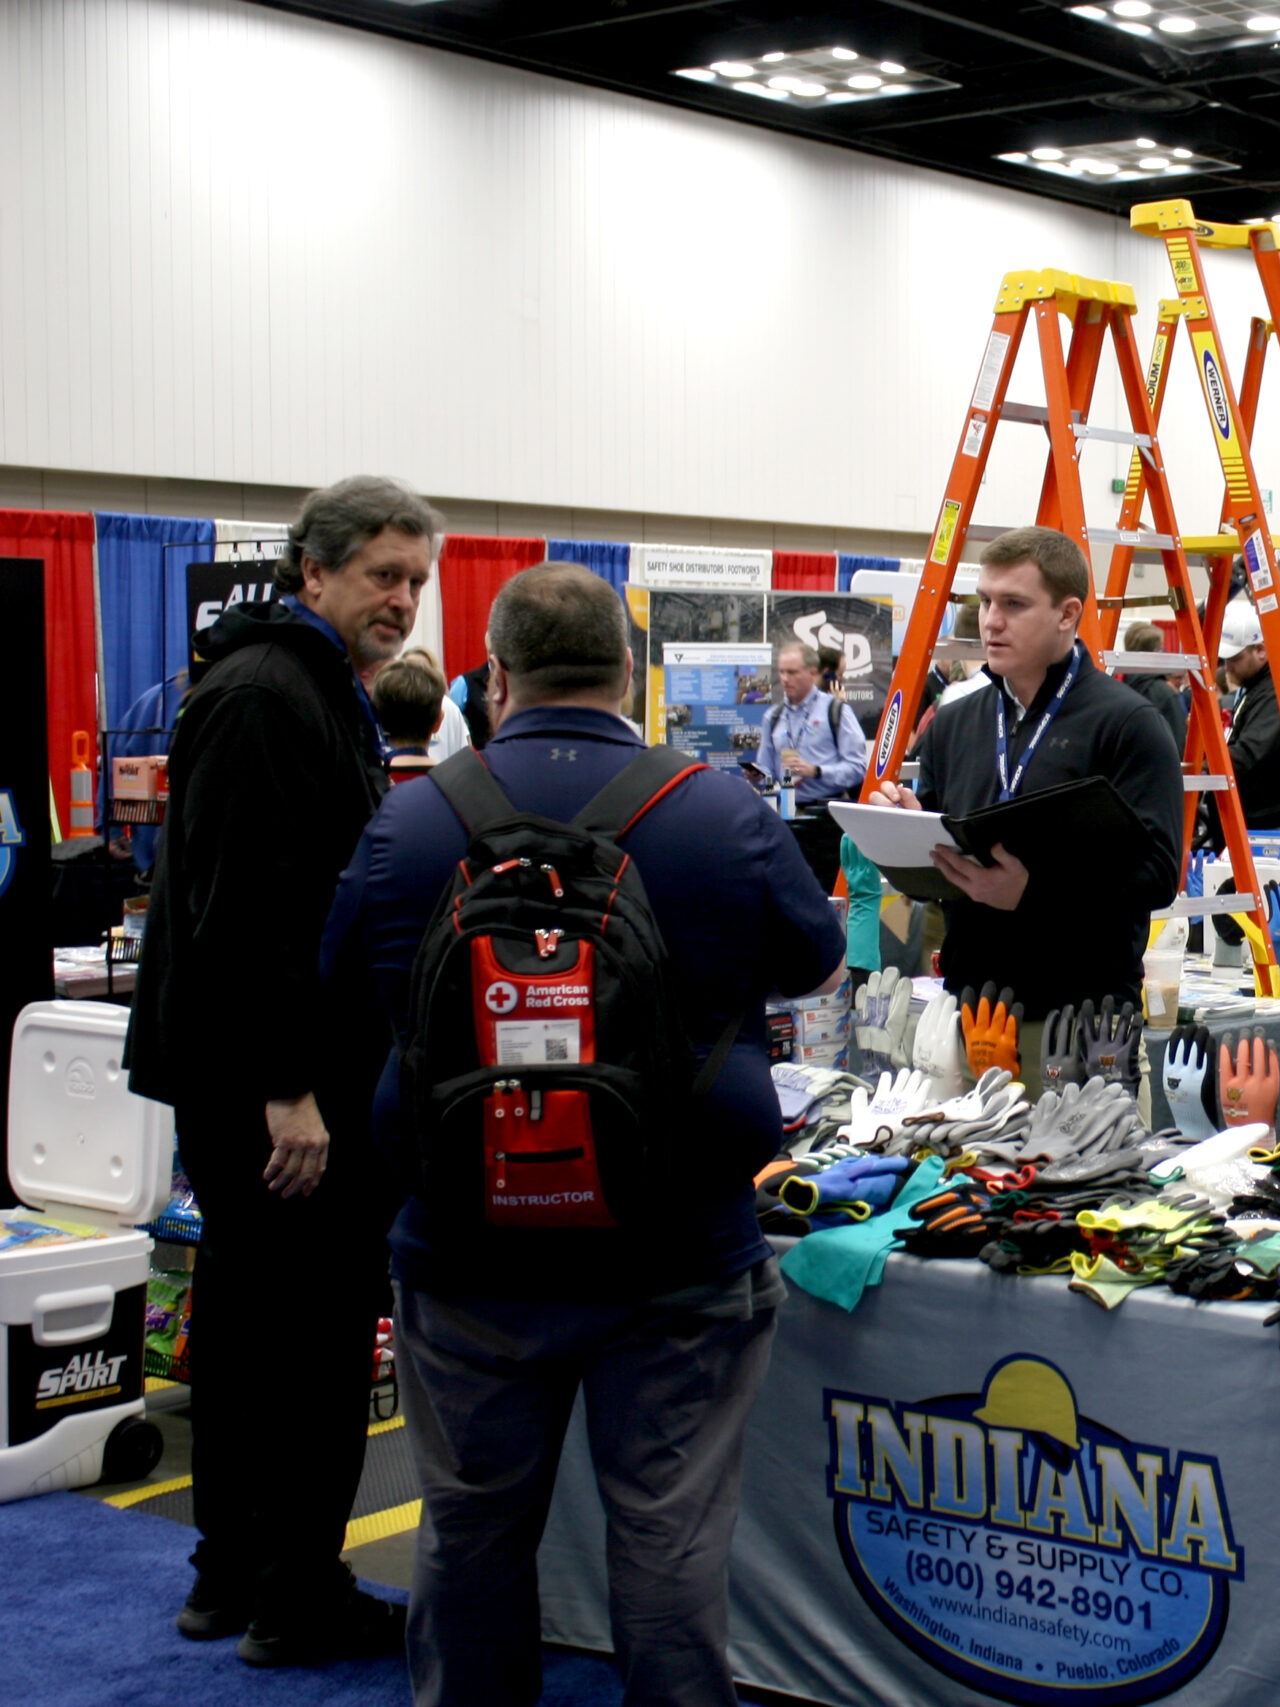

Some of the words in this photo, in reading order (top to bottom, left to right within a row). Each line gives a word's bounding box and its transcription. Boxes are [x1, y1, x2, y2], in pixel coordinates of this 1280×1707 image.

[1207, 367, 1226, 424] WERNER
[647, 561, 668, 572] SAFETY
[669, 562, 684, 573] SHOE
[686, 563, 724, 575] DISTRIBUTORS
[728, 564, 761, 576] FOOTWORKS
[880, 707, 898, 760] WERNER
[525, 984, 589, 997] American
[525, 996, 552, 1008] Red
[552, 995, 590, 1007] Cross
[492, 1190, 595, 1206] INSTRUCTOR
[35, 1354, 128, 1399] SPORT
[63, 1350, 106, 1375] ALL
[828, 1397, 1239, 1574] INDIANA
[866, 1510, 977, 1554] SAFETY
[985, 1534, 1008, 1560] &
[1016, 1540, 1131, 1587] SUPPLY
[1140, 1566, 1190, 1600] CO.
[905, 1549, 984, 1600] (800)
[994, 1569, 1152, 1631] 942-8901
[882, 1575, 964, 1650] Washington,
[969, 1637, 1024, 1672] Indiana
[1056, 1660, 1114, 1681] Pueblo,
[1116, 1635, 1182, 1677] Colorado
[928, 1594, 1132, 1653] www.indianasafety.com
